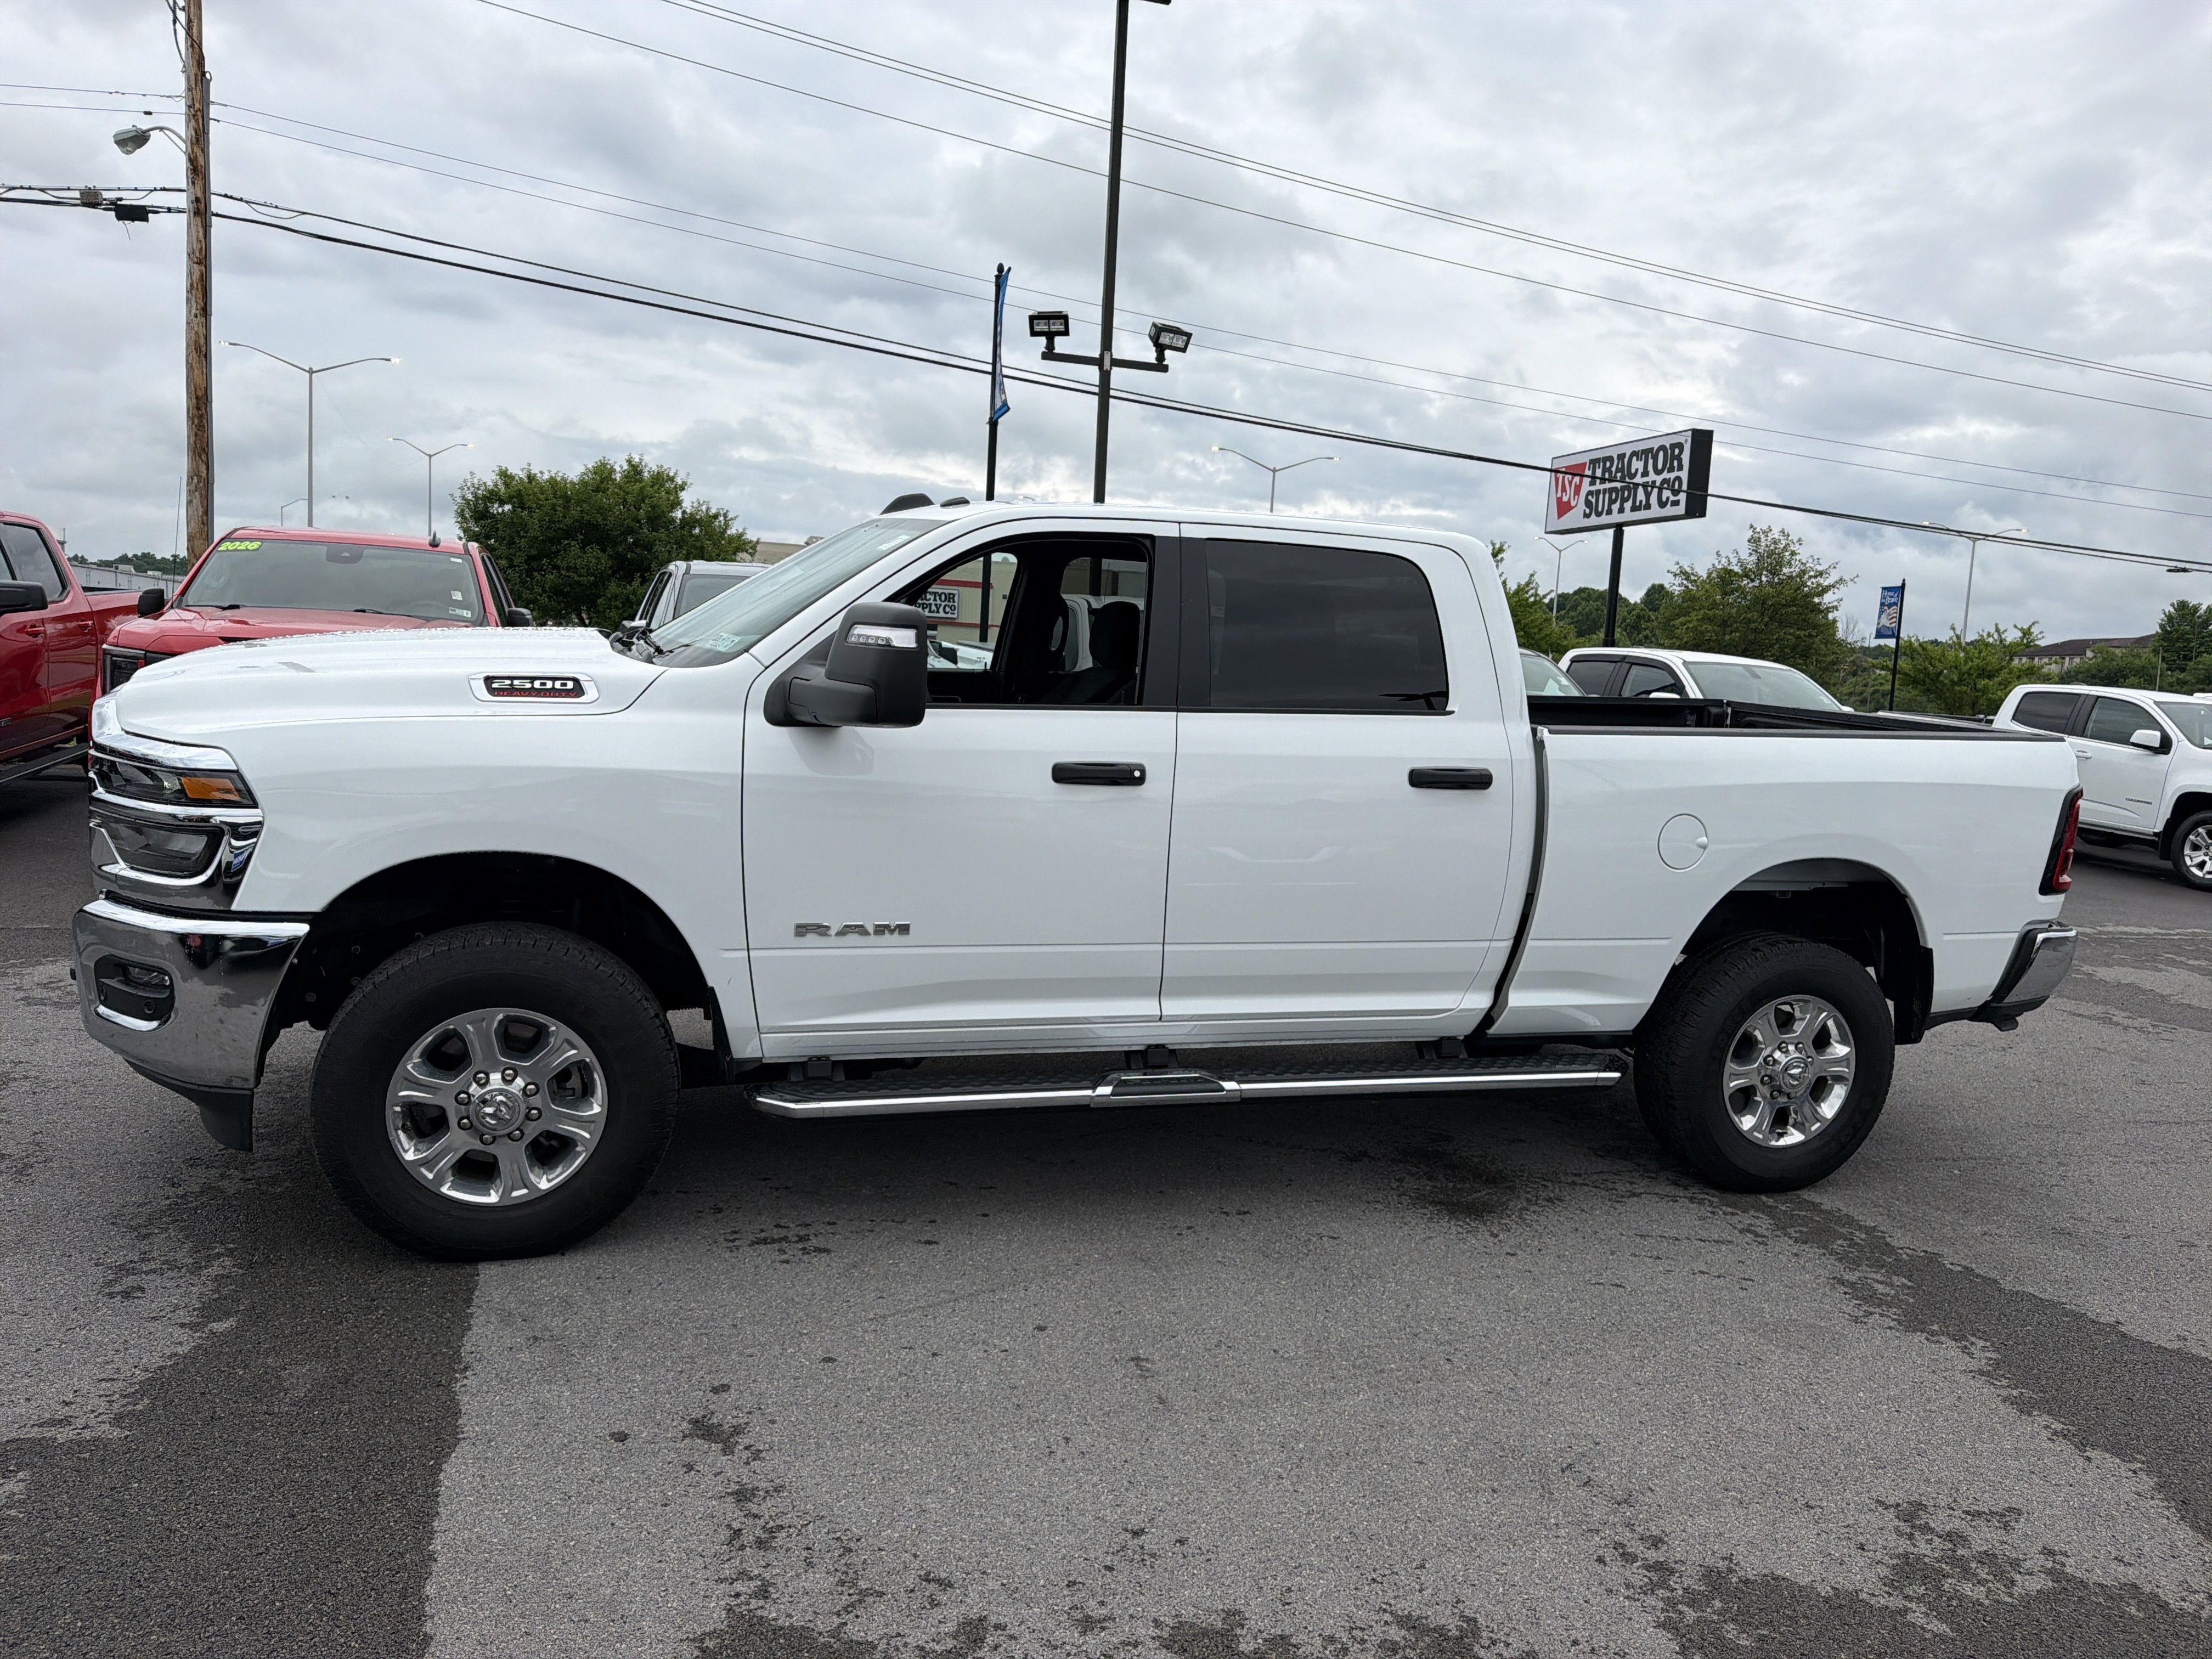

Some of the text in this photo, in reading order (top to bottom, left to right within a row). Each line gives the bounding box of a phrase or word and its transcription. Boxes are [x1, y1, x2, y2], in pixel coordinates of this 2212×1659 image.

[1588, 442, 1684, 487] TRACTOR
[1556, 467, 1581, 507] TSC
[1583, 480, 1657, 519] SUPPLY
[217, 541, 262, 551] 2026
[920, 591, 956, 603] CTOR
[914, 602, 942, 614] PPLY
[492, 679, 574, 689] 2500
[794, 921, 911, 937] RAM
